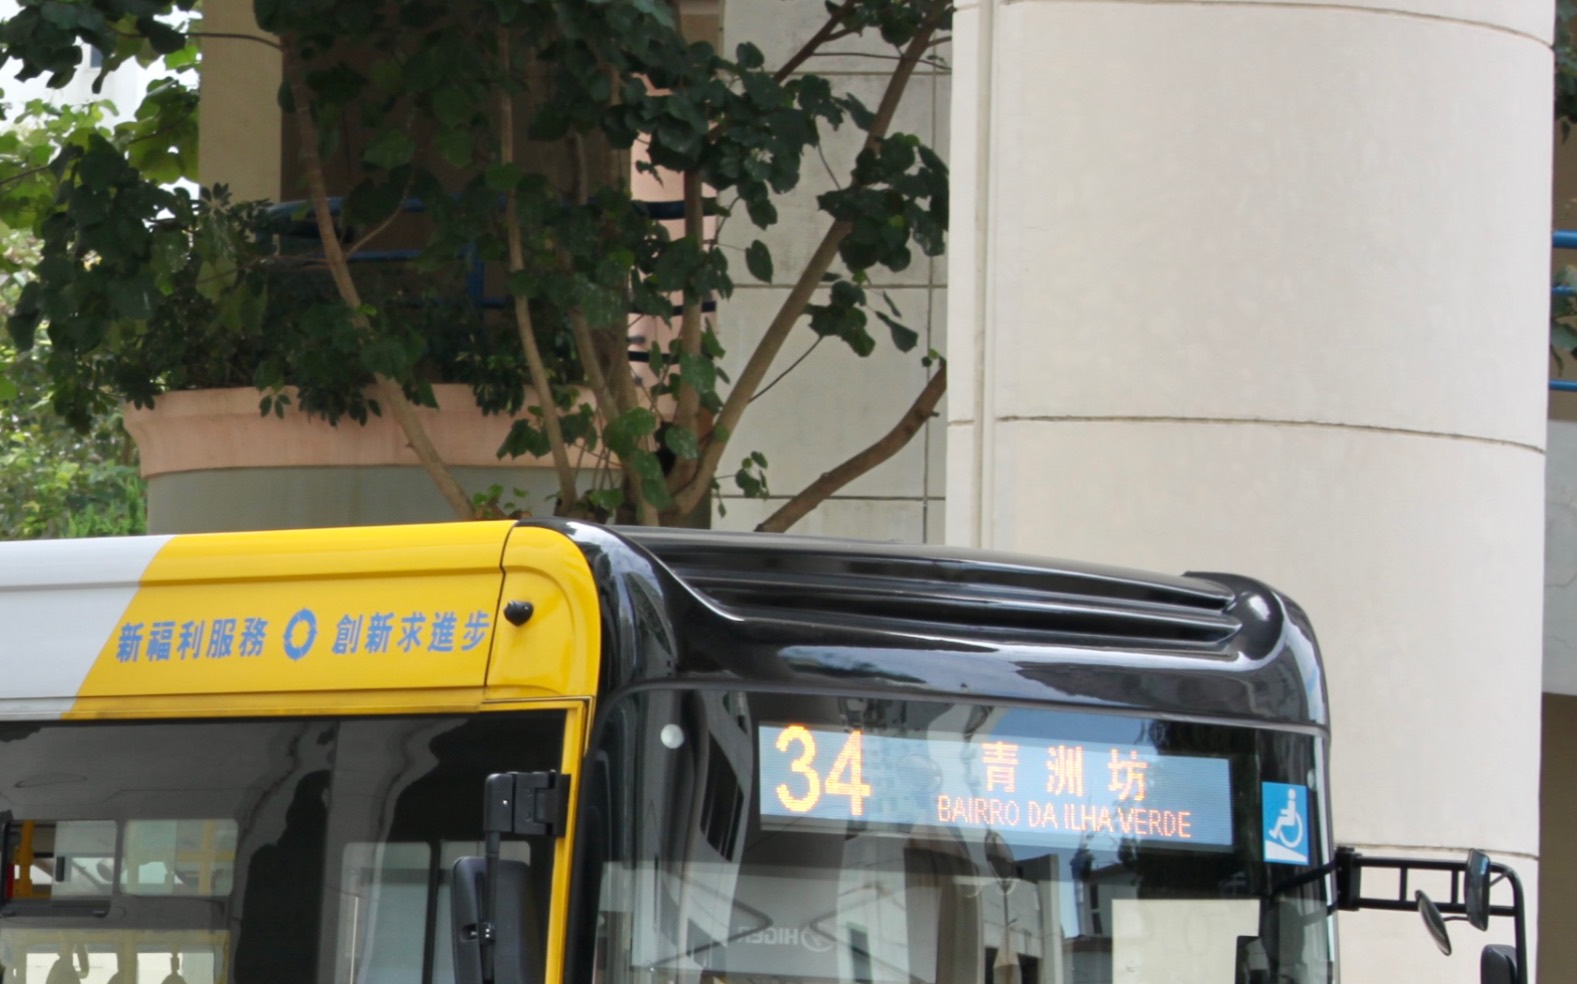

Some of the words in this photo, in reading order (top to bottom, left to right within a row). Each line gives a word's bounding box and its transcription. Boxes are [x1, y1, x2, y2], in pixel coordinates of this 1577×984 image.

[115, 616, 270, 663] 新福利服務
[331, 609, 491, 655] 創新求進步
[775, 724, 871, 817] 34
[981, 741, 1148, 801] 青洲坊
[937, 794, 1021, 827] BAIRRO
[1027, 800, 1059, 829] DA
[1064, 803, 1114, 833] ILHA
[1117, 808, 1192, 838] VERDE
